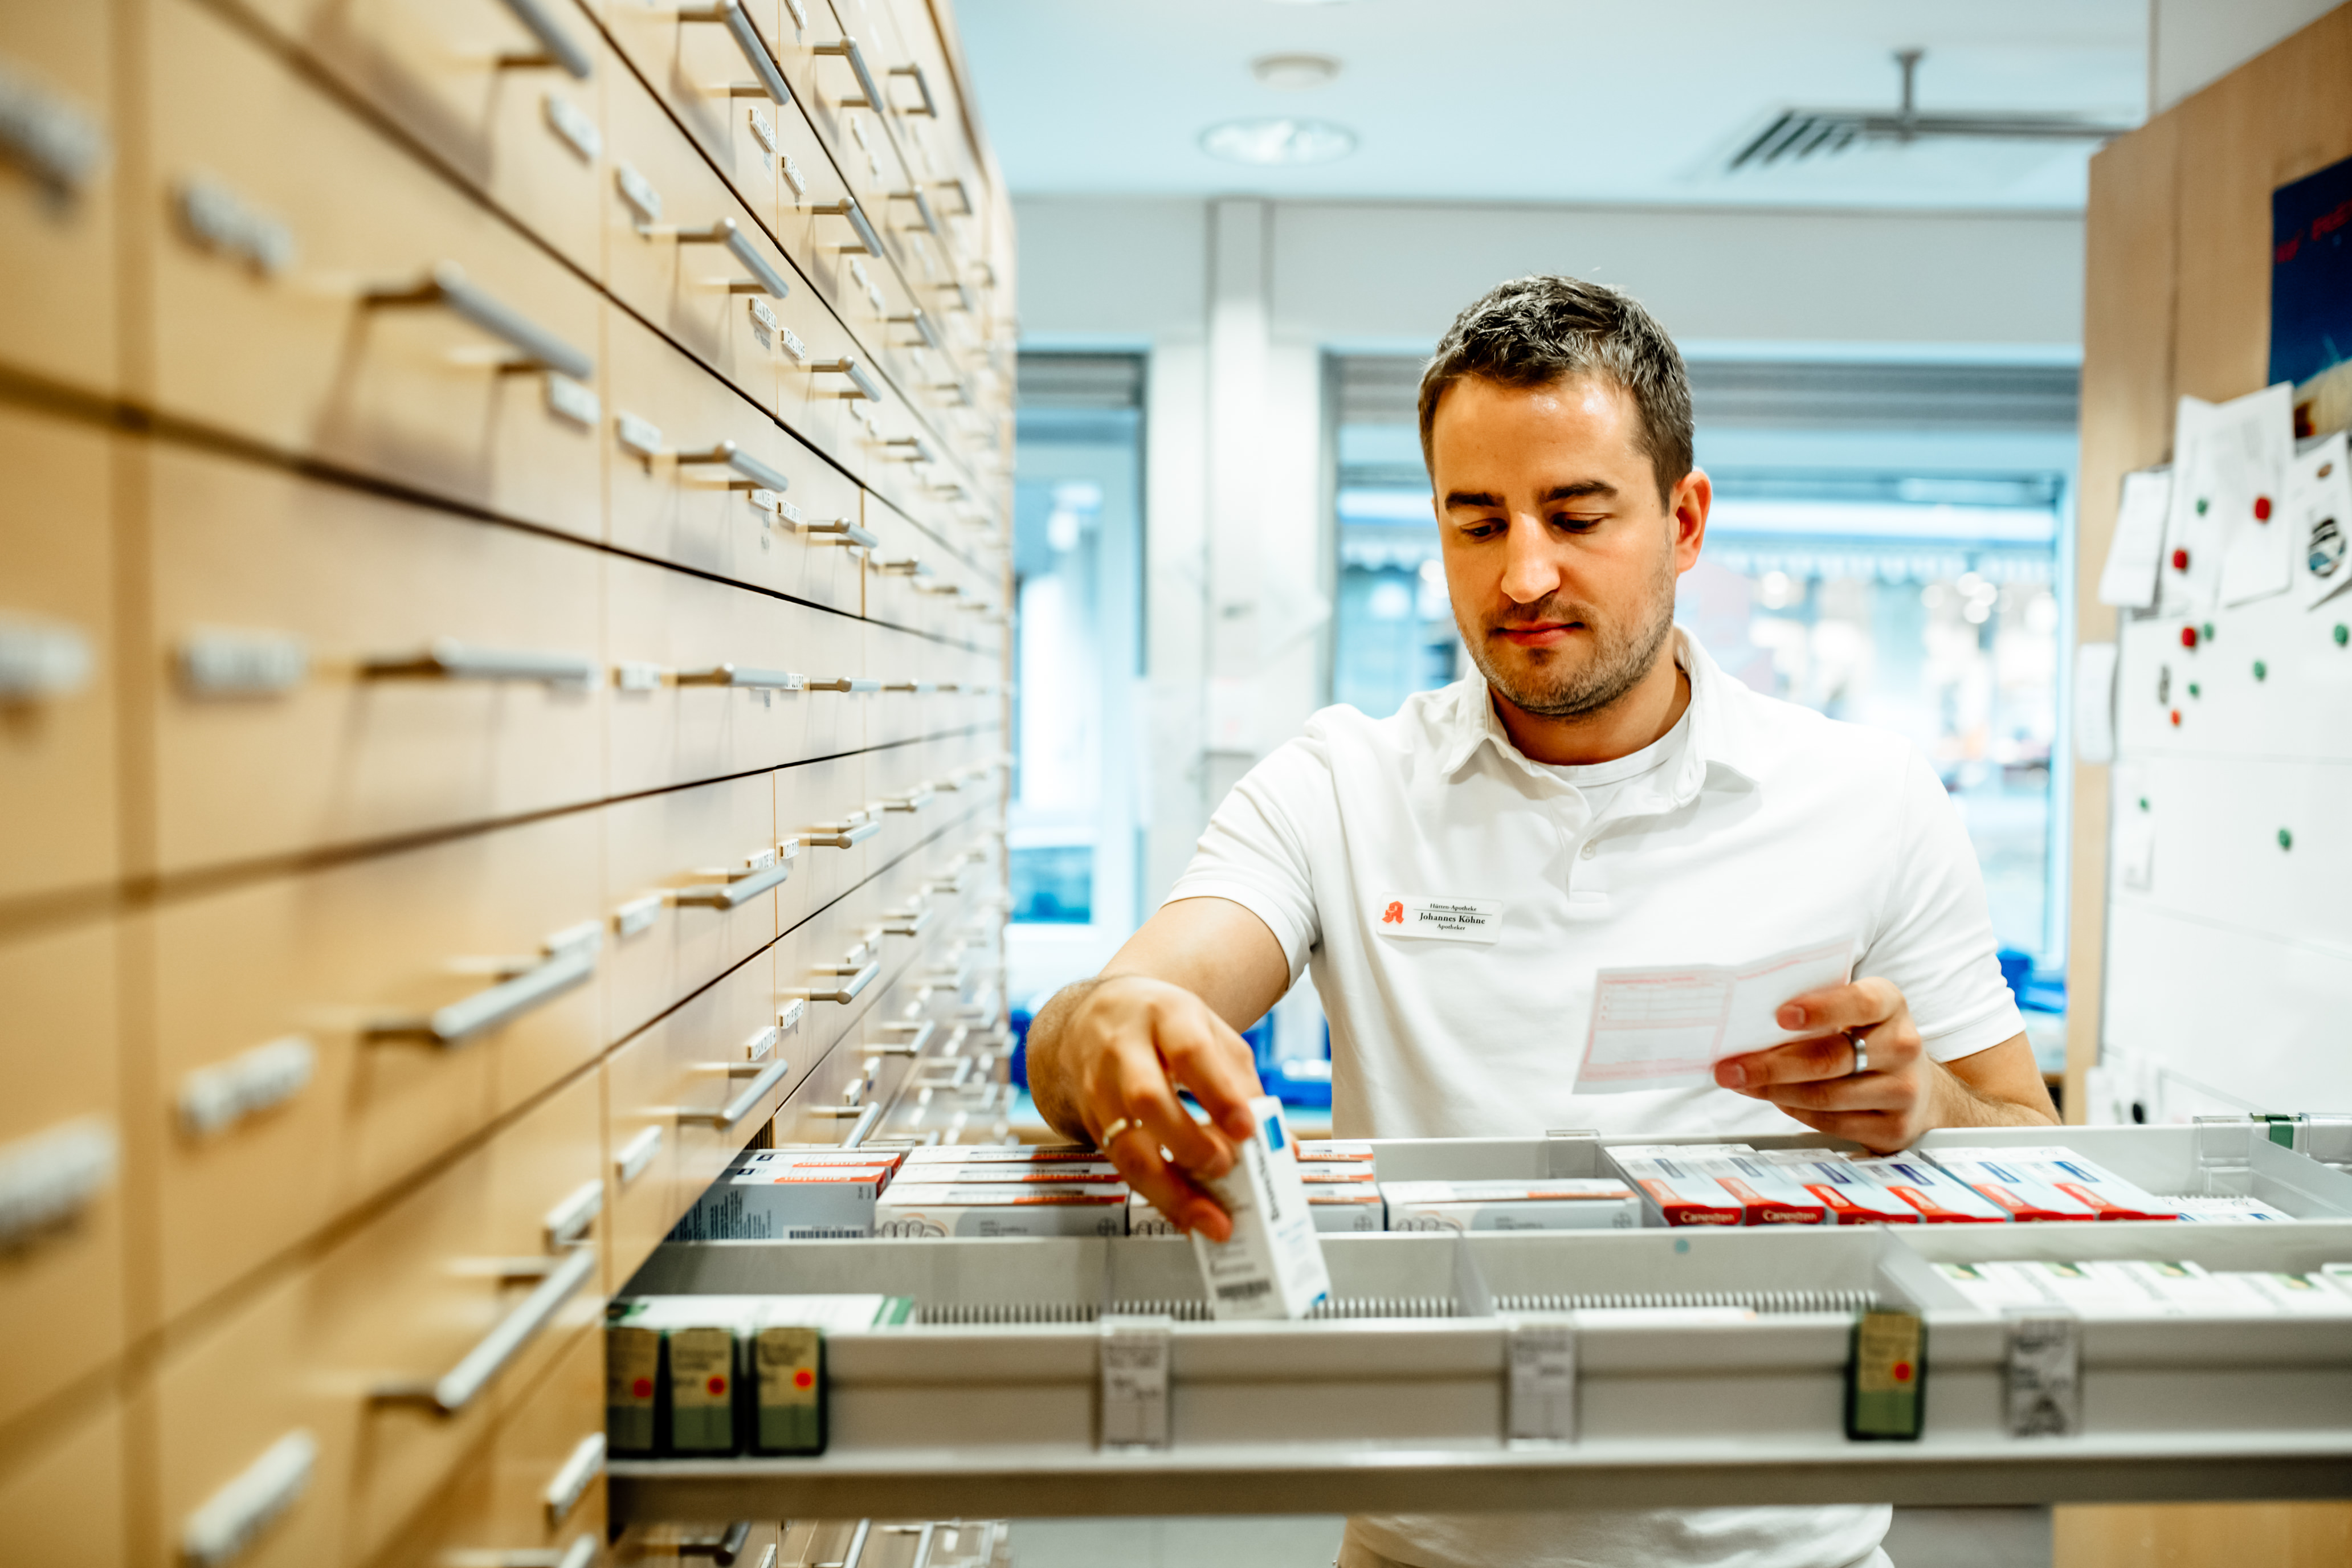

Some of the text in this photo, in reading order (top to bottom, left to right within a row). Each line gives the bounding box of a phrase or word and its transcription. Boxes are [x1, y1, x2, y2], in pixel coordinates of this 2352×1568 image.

[1430, 903, 1477, 912] Hütten-Apotheke
[1419, 913, 1485, 924] Johannes Köhne
